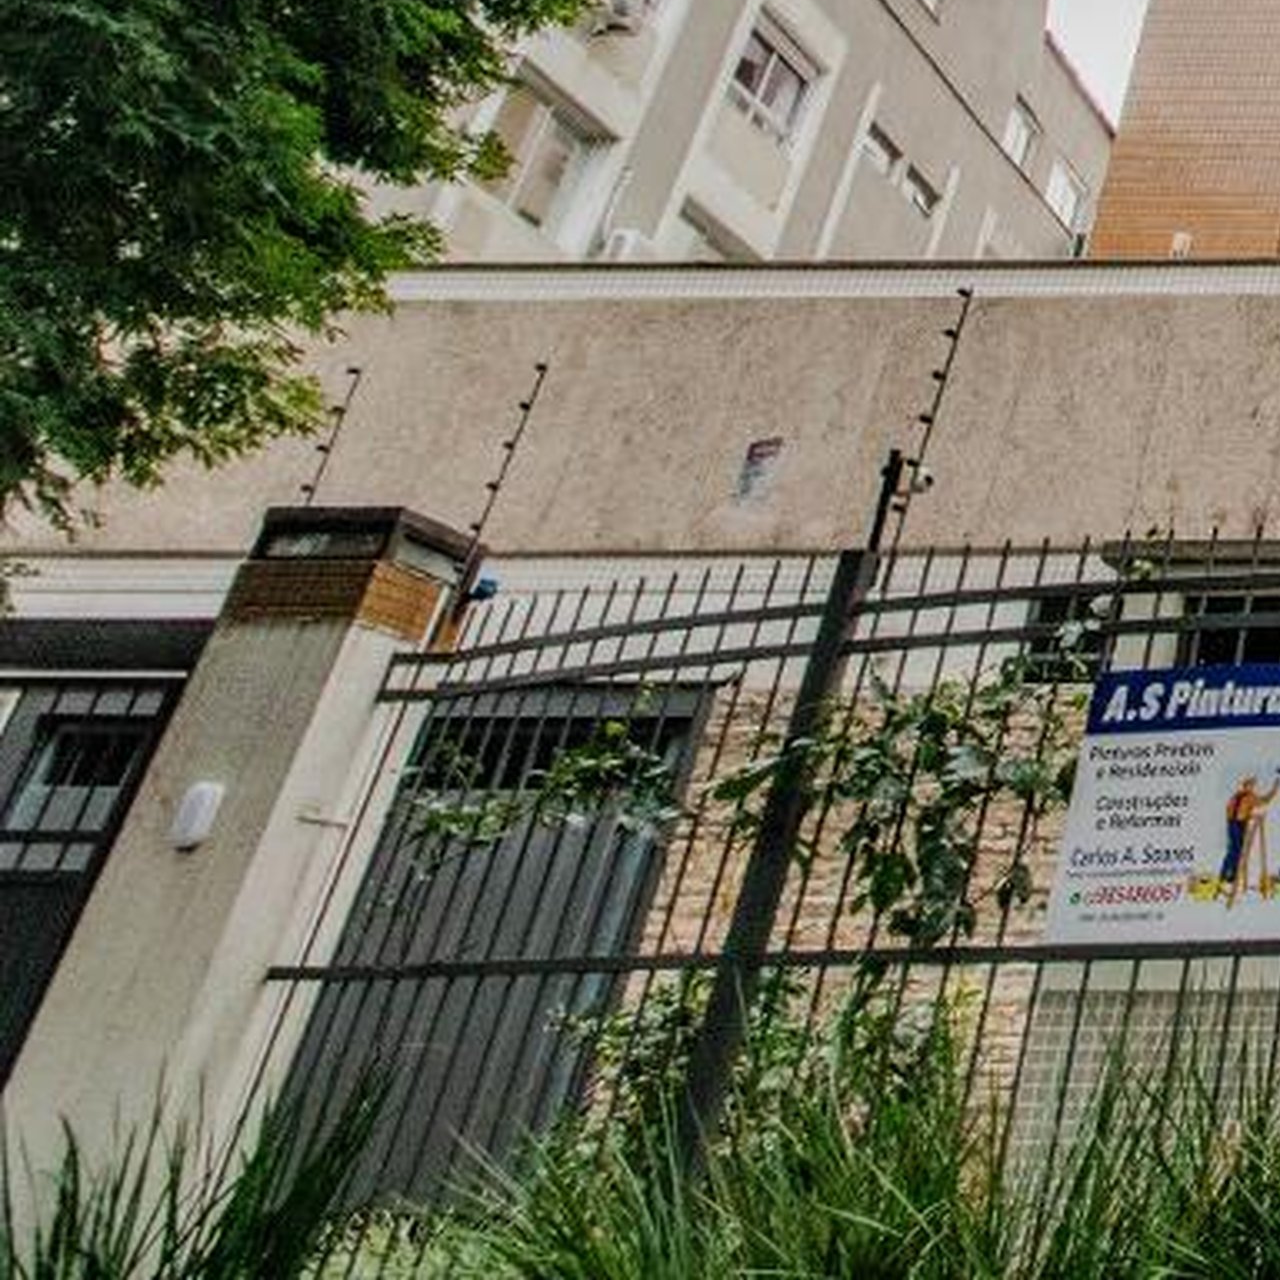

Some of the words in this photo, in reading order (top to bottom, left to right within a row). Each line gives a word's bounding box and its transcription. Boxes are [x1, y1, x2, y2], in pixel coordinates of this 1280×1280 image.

[1101, 683, 1165, 722] A.S
[1089, 746, 1151, 761] Pinturas
[1095, 817, 1106, 830] e
[1109, 813, 1182, 829] Reformas
